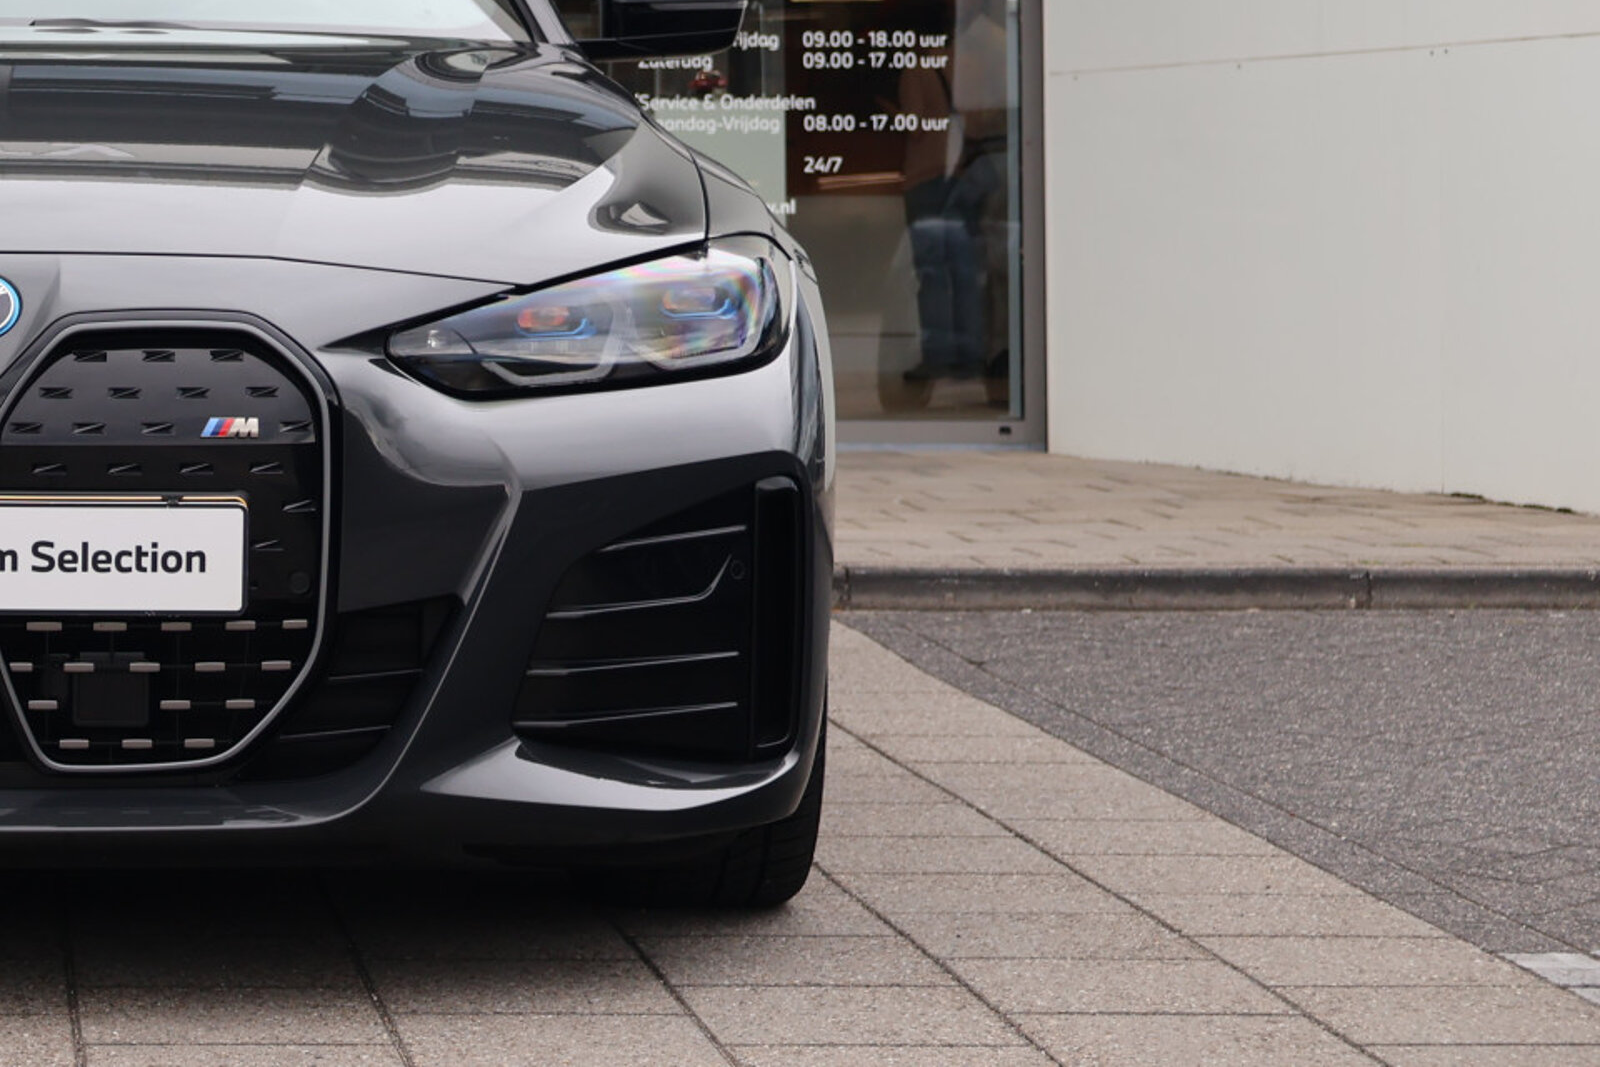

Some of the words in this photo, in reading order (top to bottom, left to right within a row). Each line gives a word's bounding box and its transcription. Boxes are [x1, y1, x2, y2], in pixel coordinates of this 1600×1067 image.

[802, 32, 853, 48] 09.00
[869, 32, 916, 48] 18.00
[919, 35, 947, 48] uur
[802, 53, 853, 69] 09.00
[869, 53, 916, 69] 17.00
[919, 56, 948, 69] uur
[639, 94, 699, 110] Service
[703, 94, 715, 110] &
[720, 94, 816, 111] Onderdelen
[657, 116, 780, 134] andag-Vrijdag
[803, 116, 854, 132] 08.00
[870, 116, 918, 132] 17.00
[921, 118, 950, 132] uur
[803, 157, 843, 173] 24/7
[31, 541, 207, 574] Selection
